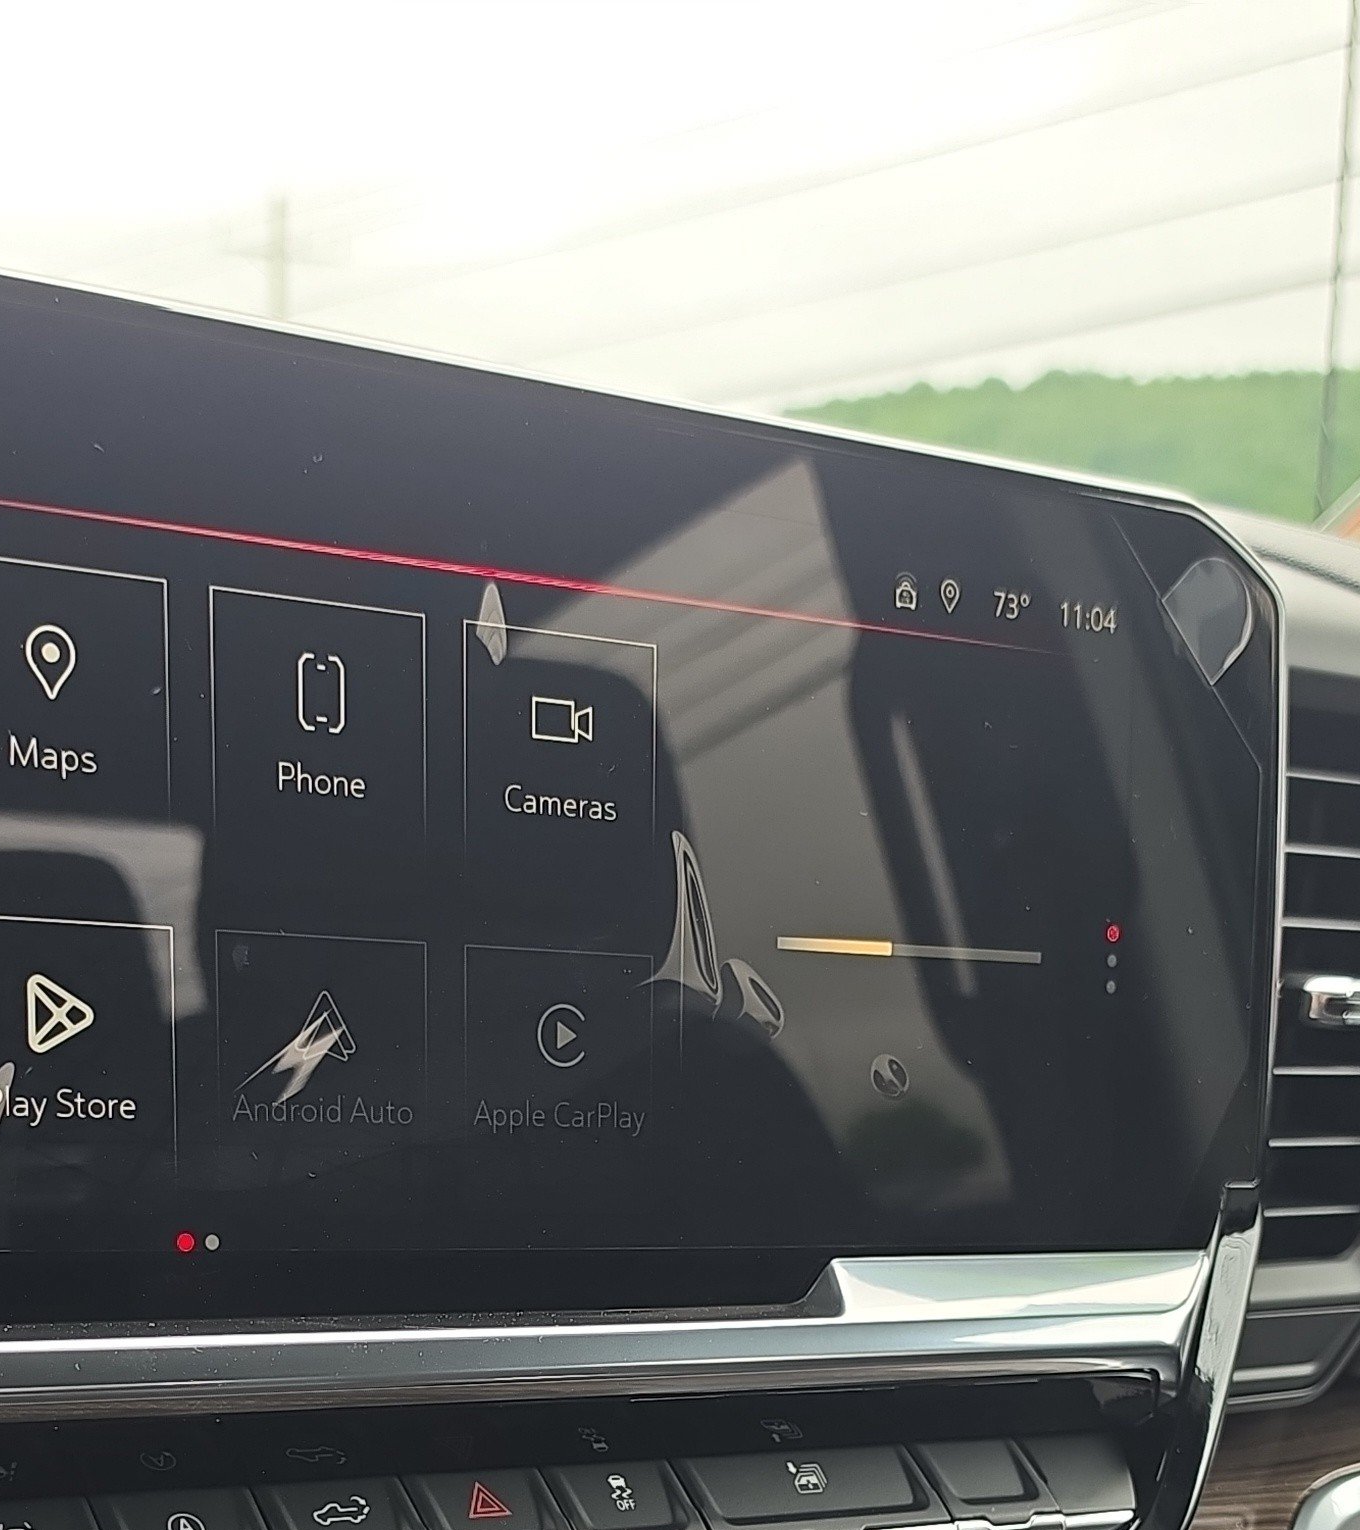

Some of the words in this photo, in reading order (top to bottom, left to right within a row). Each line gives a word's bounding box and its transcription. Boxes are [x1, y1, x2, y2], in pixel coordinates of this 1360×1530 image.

[1060, 601, 1117, 634] 11:04
[8, 735, 98, 780] Maps
[276, 762, 366, 800] Phone
[503, 784, 618, 822] Cameras
[55, 1088, 137, 1120] Store
[232, 1093, 343, 1124] Android
[349, 1097, 414, 1126] Auto
[473, 1099, 545, 1132] Apple
[553, 1101, 646, 1137] CarPlay
[617, 1500, 635, 1511] OFF
